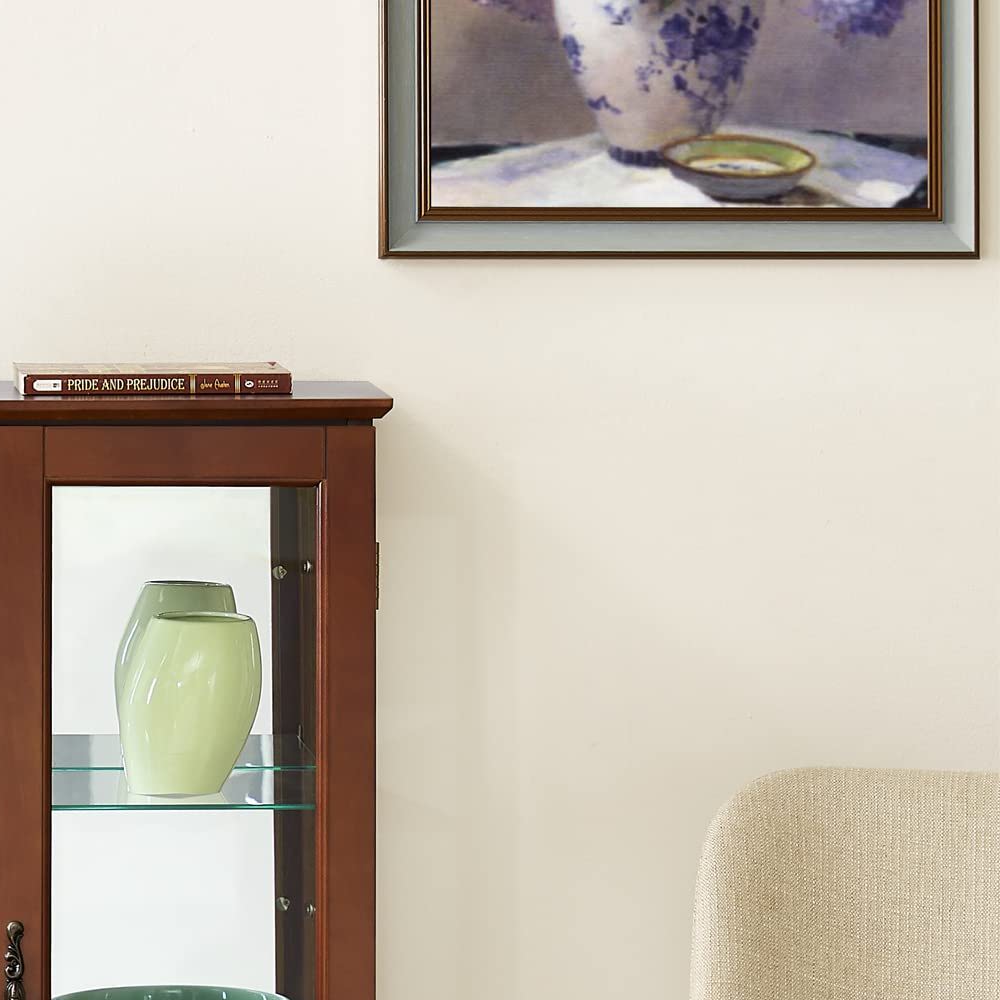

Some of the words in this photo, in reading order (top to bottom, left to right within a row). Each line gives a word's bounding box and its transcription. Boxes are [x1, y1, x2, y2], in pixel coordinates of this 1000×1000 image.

[66, 378, 99, 391] PRIDE
[101, 378, 124, 391] AND
[126, 378, 185, 391] PREJUDICE
